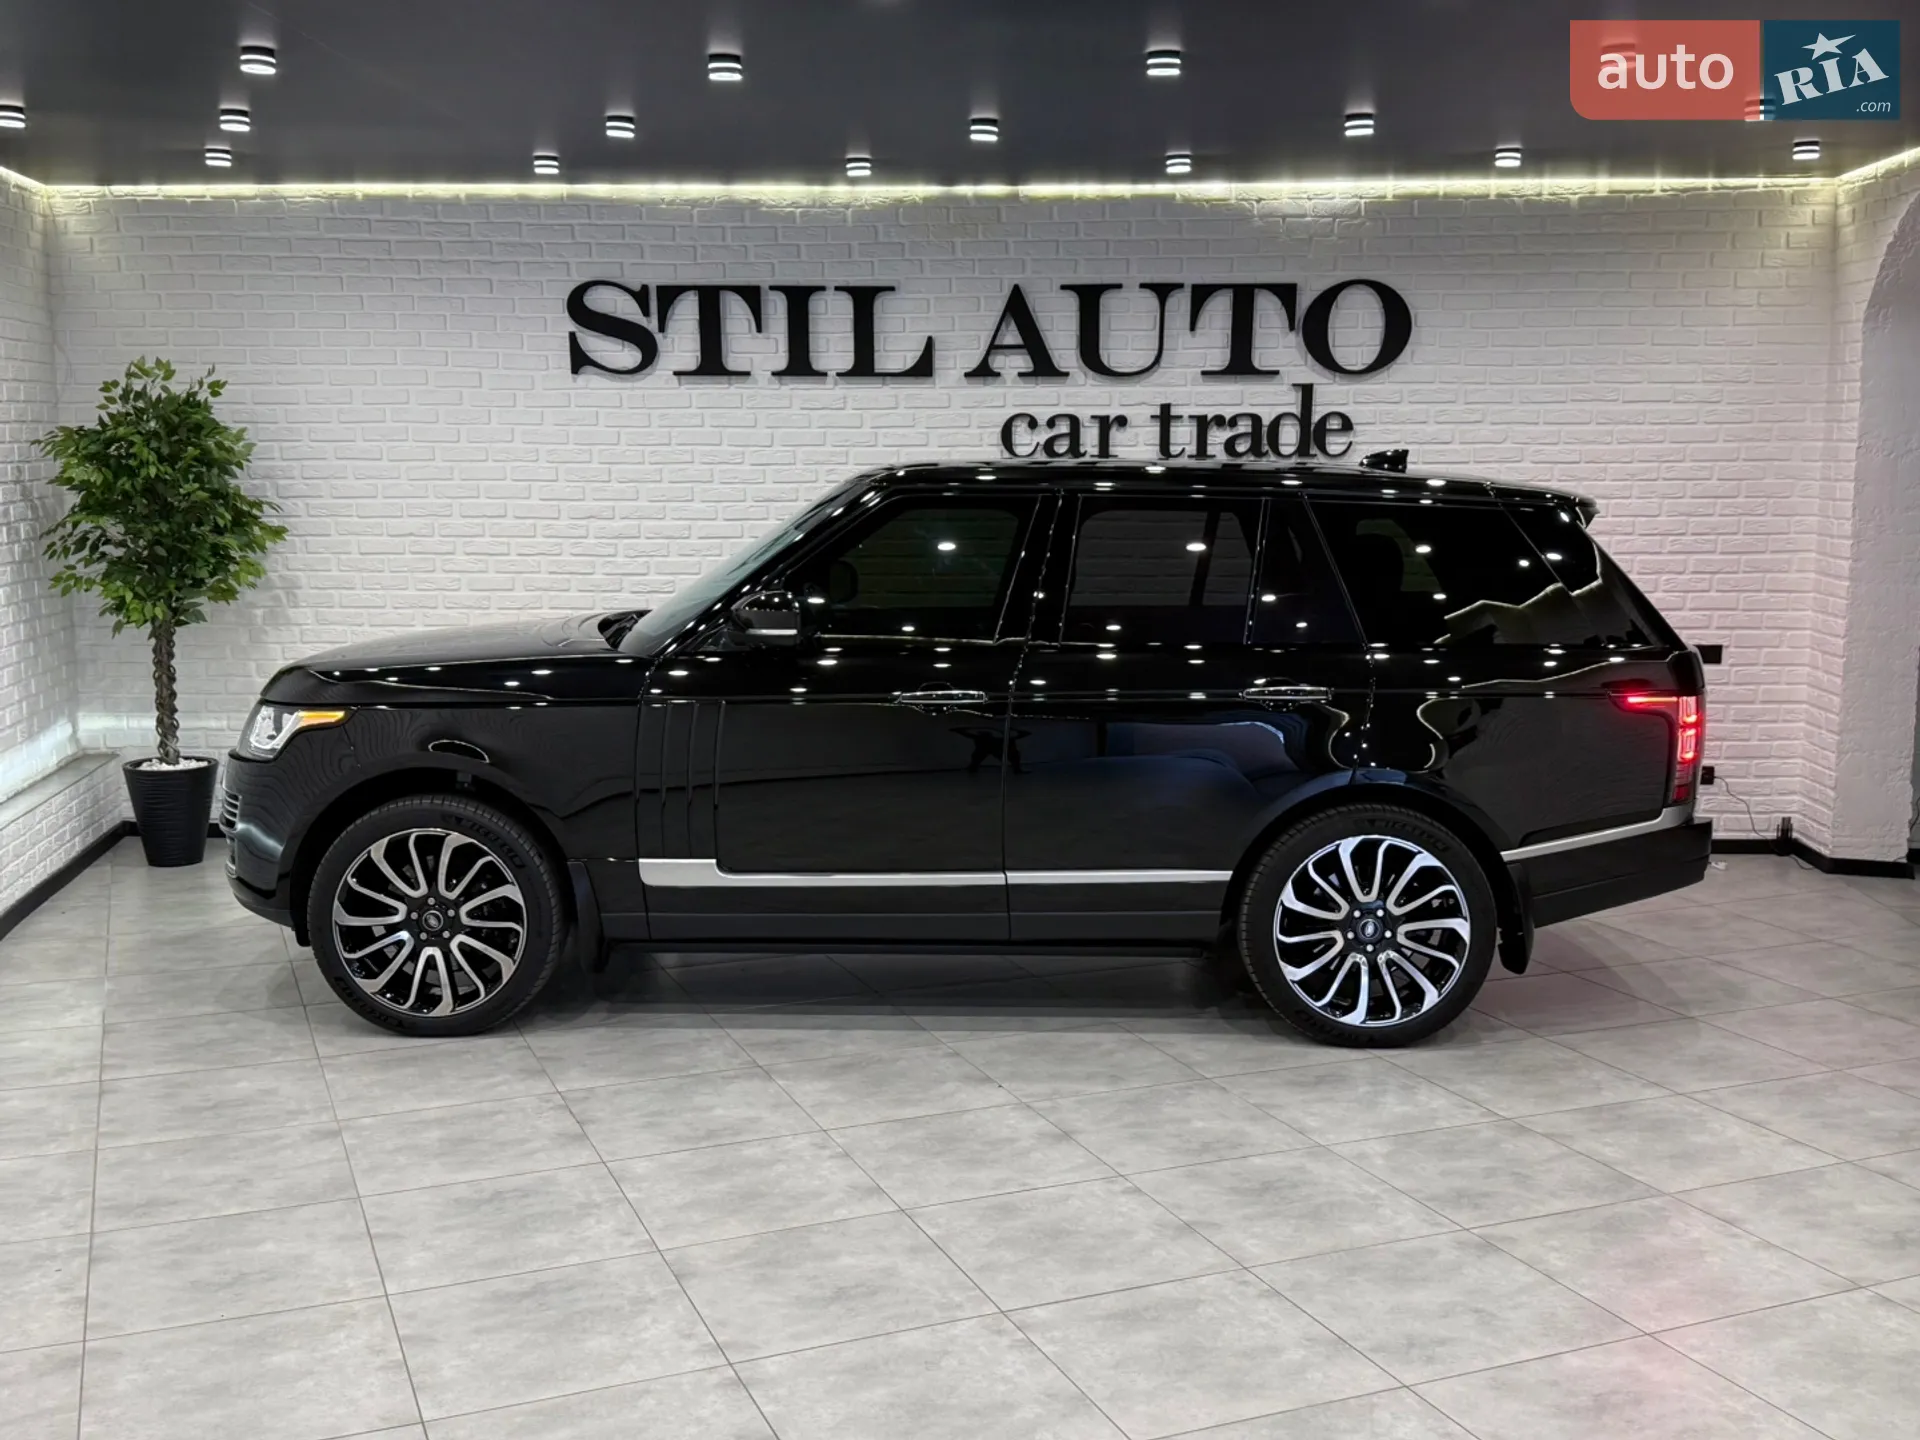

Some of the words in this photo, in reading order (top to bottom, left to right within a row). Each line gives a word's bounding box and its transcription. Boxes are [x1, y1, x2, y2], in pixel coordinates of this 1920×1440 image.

[567, 279, 934, 378] STIL
[964, 279, 1413, 378] AUTO
[1001, 413, 1128, 460] car
[1151, 383, 1354, 460] trade
